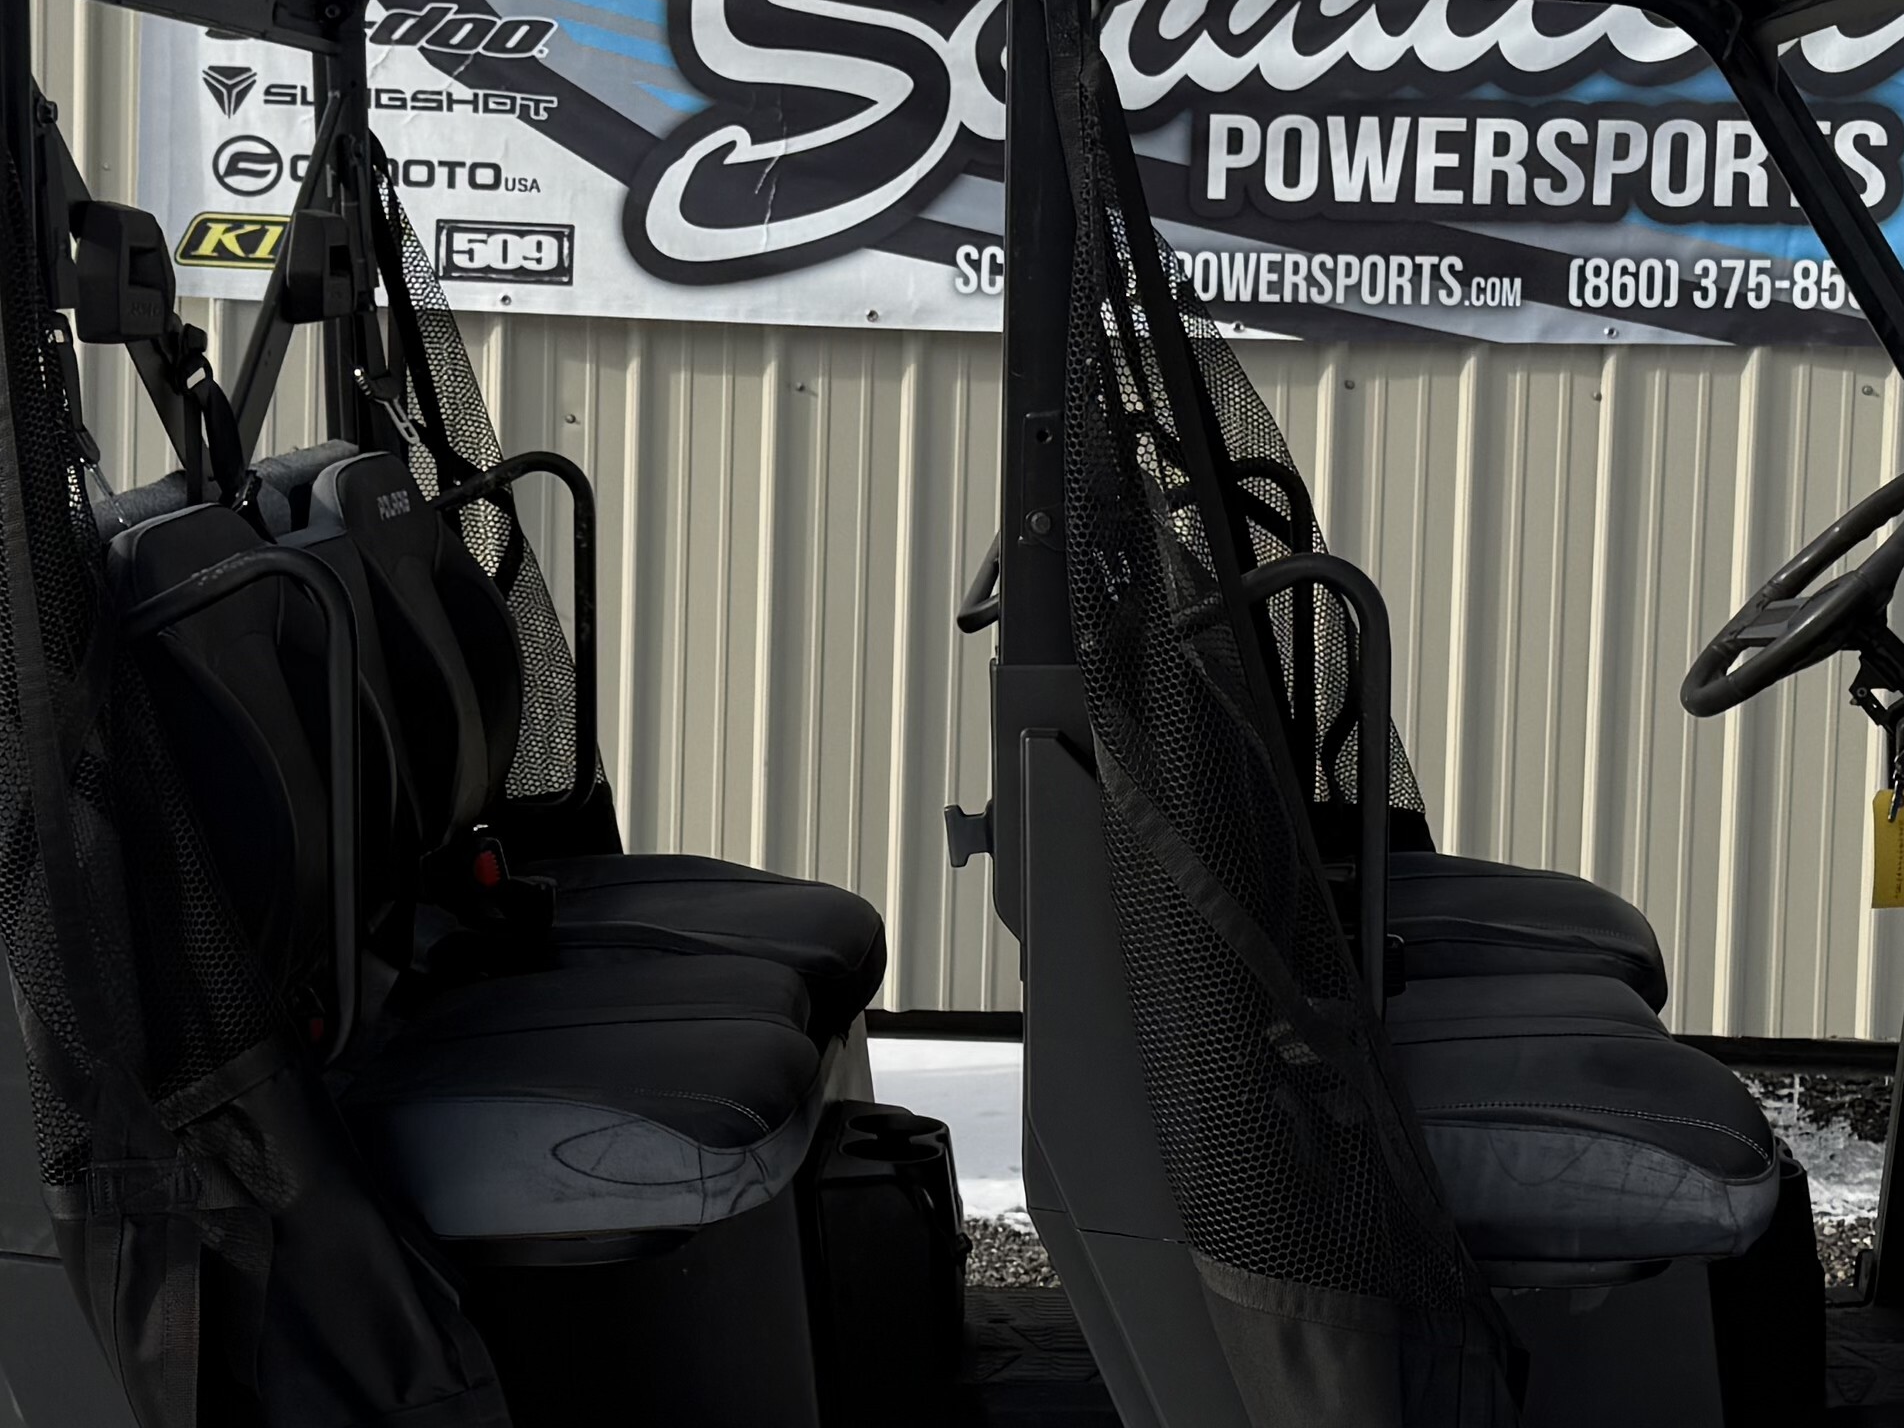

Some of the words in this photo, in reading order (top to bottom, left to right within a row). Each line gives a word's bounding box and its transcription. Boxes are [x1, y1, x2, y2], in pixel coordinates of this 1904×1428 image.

[262, 82, 558, 121] SLGSHOT
[1207, 114, 1889, 210] POWERSPORS
[504, 177, 541, 194] USA
[451, 232, 559, 271] 509
[1568, 257, 1680, 309] (860)
[1692, 258, 1865, 310] 375-85
